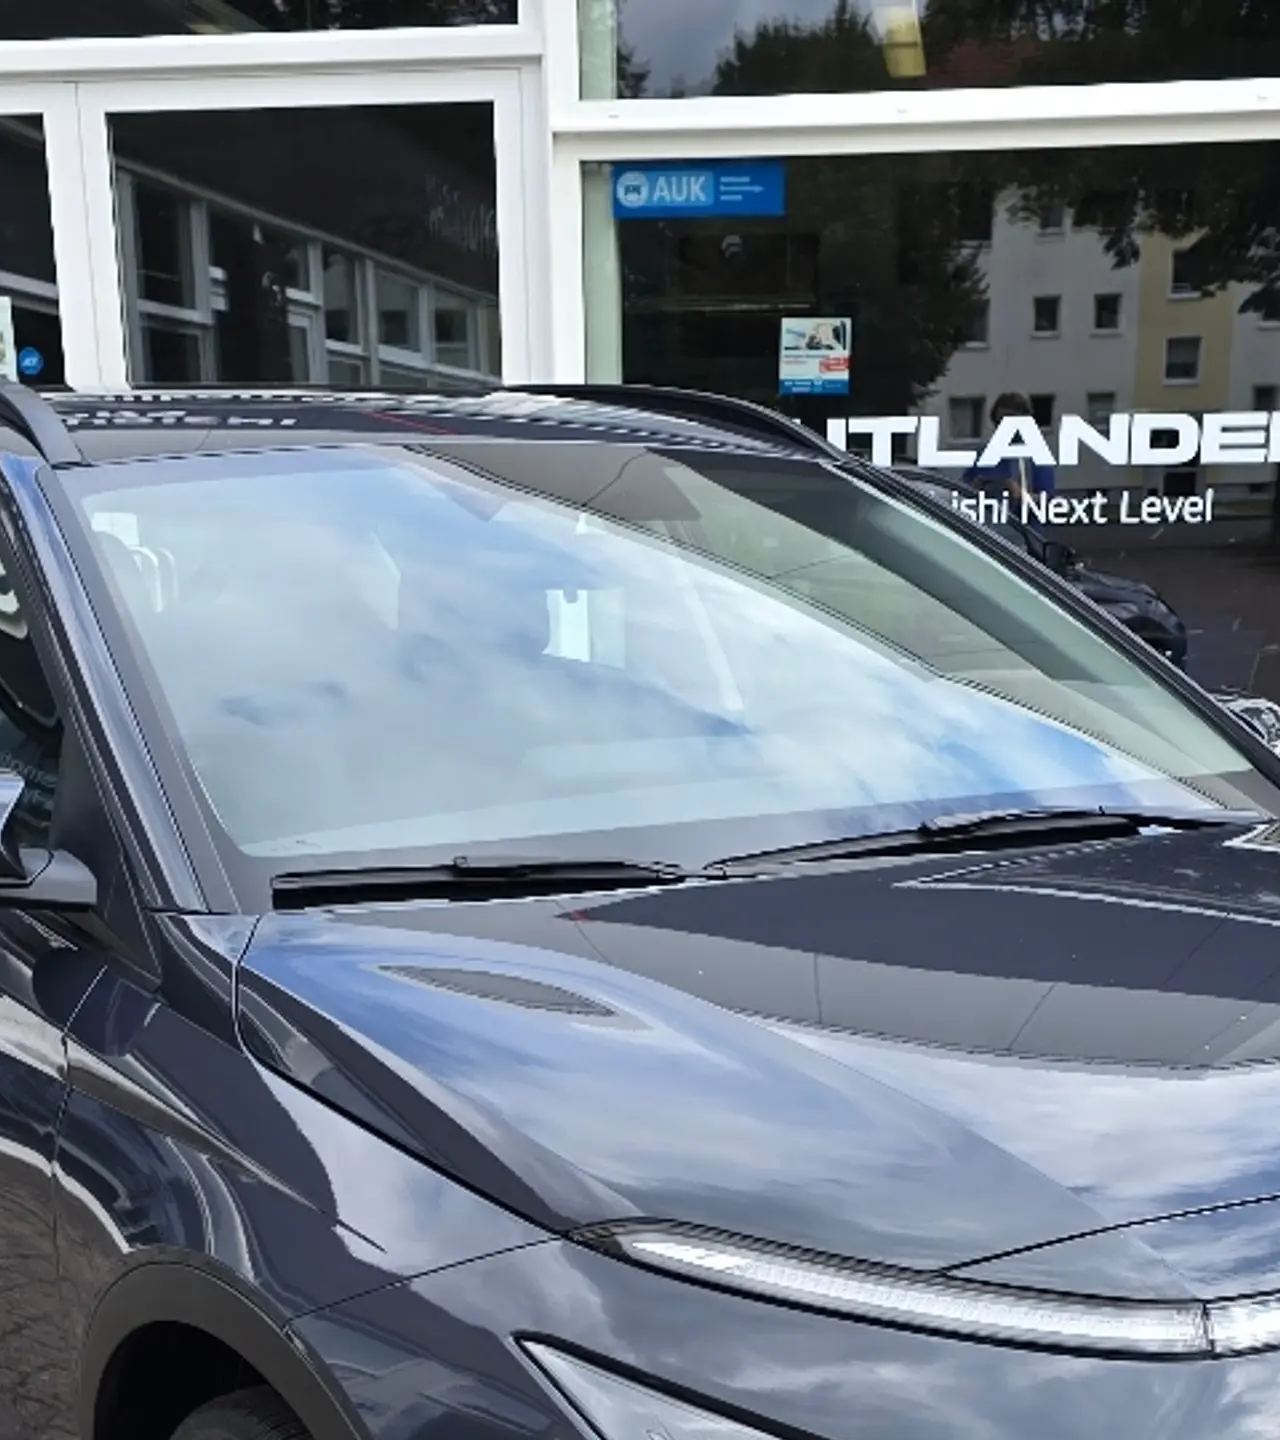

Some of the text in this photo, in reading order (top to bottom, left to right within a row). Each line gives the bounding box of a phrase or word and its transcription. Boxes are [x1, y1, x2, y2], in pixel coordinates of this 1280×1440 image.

[654, 176, 707, 202] AUK
[1021, 490, 1108, 525] Next
[1121, 487, 1214, 524] Level
